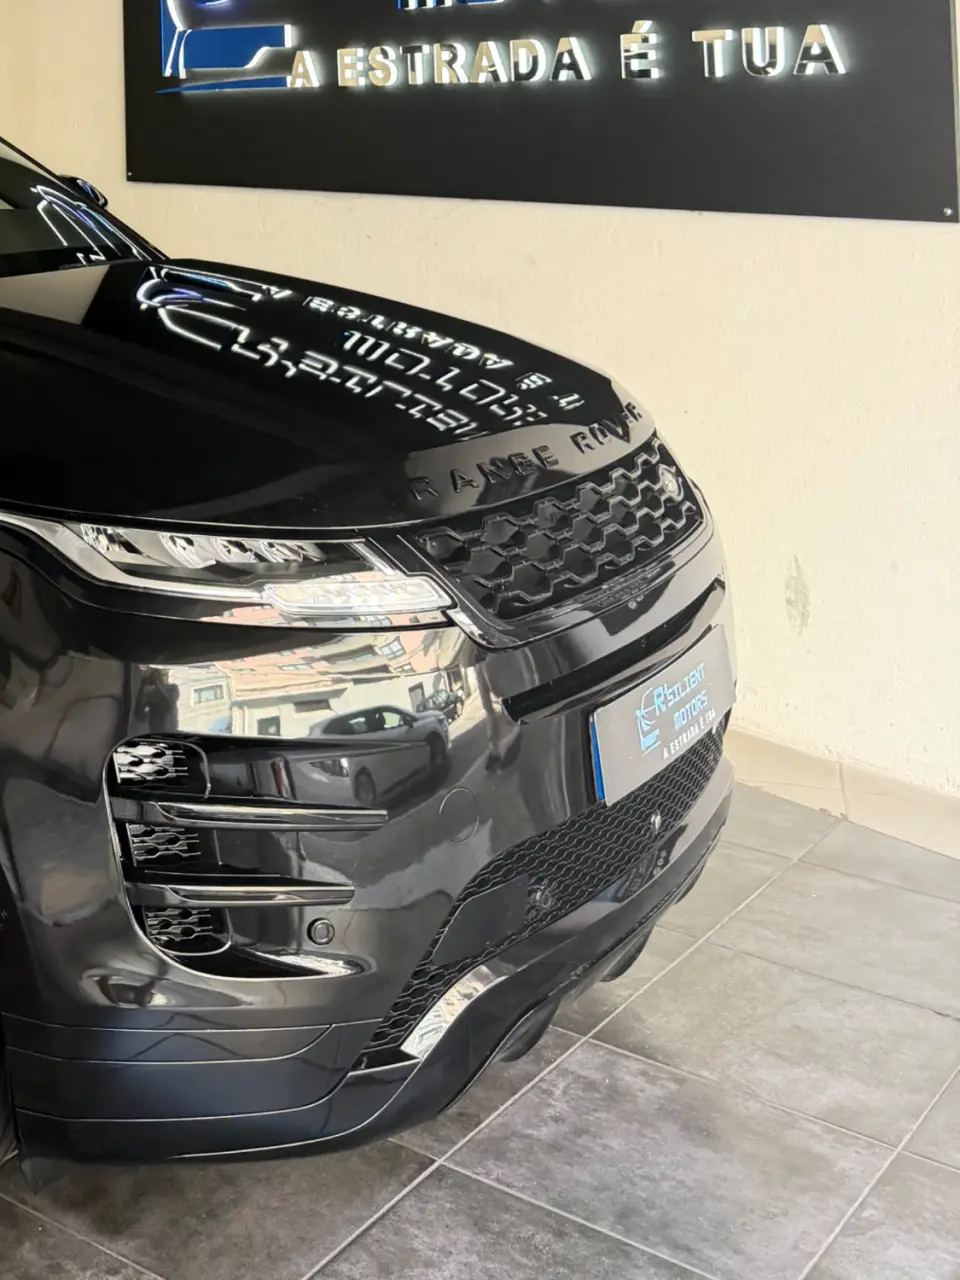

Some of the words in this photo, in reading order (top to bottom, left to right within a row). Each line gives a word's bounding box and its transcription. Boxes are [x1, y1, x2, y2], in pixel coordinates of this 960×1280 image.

[289, 48, 320, 88] A
[337, 37, 593, 87] ESTRADA
[620, 20, 661, 79] É
[692, 23, 849, 77] TUA
[408, 444, 560, 501] RANGE
[569, 400, 644, 454] ROVER
[673, 688, 708, 730] MOTORS
[663, 747, 669, 760] A
[670, 723, 700, 754] ESTRADA
